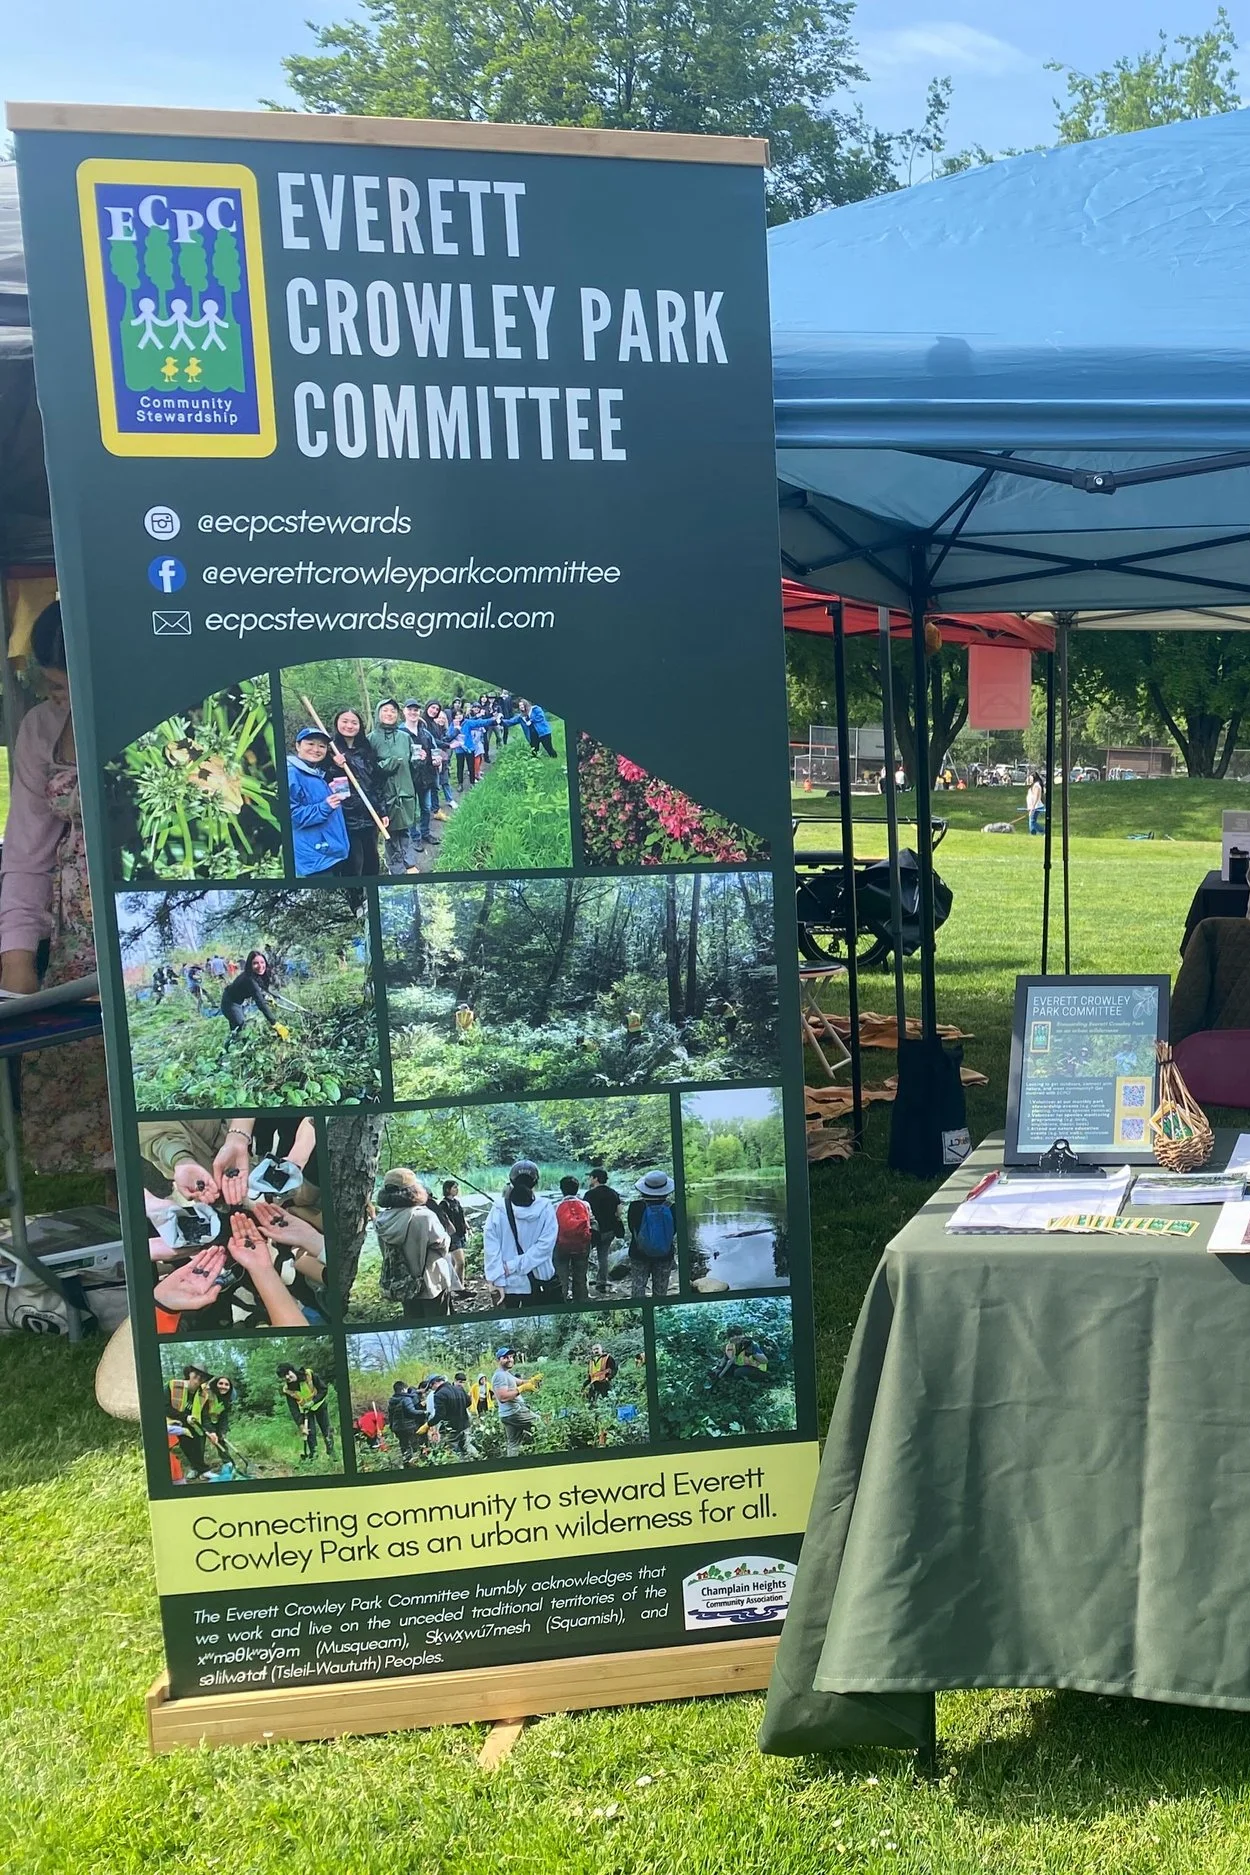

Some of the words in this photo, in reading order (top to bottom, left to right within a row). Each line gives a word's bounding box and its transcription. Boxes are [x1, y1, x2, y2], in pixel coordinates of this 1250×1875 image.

[104, 194, 237, 243] ECPC
[277, 172, 526, 257] EVERETT
[285, 276, 556, 360] CROWLEY
[580, 287, 728, 364] PARK
[136, 410, 238, 425] Stewardship
[140, 396, 232, 411] Community
[294, 381, 627, 461] COMMITTEE
[197, 506, 412, 541] @ecpcstewards
[202, 556, 621, 593] @everettcrowleyparkcommittee
[205, 601, 555, 639] ecpcstewards@gmail.com
[1032, 1007, 1060, 1016] PARK
[1062, 1006, 1122, 1016] COMMITTEE
[1033, 996, 1078, 1006] EVERETT
[1080, 995, 1131, 1005] CROWLEY
[192, 1511, 358, 1540] Connecting
[366, 1493, 517, 1529] community
[523, 1491, 551, 1511] to
[559, 1472, 666, 1507] steward
[674, 1467, 765, 1496] Everett
[196, 1542, 312, 1573] Crowley
[321, 1535, 380, 1563] Park
[388, 1539, 419, 1558] as
[427, 1535, 461, 1553] an
[471, 1521, 548, 1549] urban
[556, 1509, 692, 1539] wilderness
[699, 1499, 735, 1524] for
[742, 1493, 777, 1519] all.
[194, 1610, 220, 1625] The
[226, 1605, 279, 1622] Everett
[285, 1600, 346, 1617] Crowley
[351, 1596, 382, 1612] Park
[388, 1588, 470, 1608] Committee
[475, 1579, 527, 1599] humbly
[531, 1570, 633, 1592] acknowledges
[638, 1565, 666, 1580] that
[701, 1584, 749, 1597] Champlain
[752, 1580, 787, 1592] Heights
[706, 1599, 745, 1608] Community
[746, 1594, 783, 1604] Association
[195, 1634, 220, 1646] we
[228, 1626, 263, 1642] work
[271, 1623, 300, 1639] and
[309, 1621, 332, 1635] live
[340, 1622, 359, 1633] on
[367, 1615, 391, 1630] the
[400, 1606, 464, 1626] unceded
[471, 1598, 543, 1618] traditional
[551, 1593, 614, 1610] territories
[622, 1586, 638, 1601] of
[645, 1585, 667, 1600] the
[315, 1633, 409, 1658] (Musqueam),
[546, 1608, 626, 1634] (Squamish),
[641, 1603, 669, 1619] and
[271, 1655, 381, 1683] (Tsleil-Waututh)
[384, 1649, 444, 1670] Peoples.
